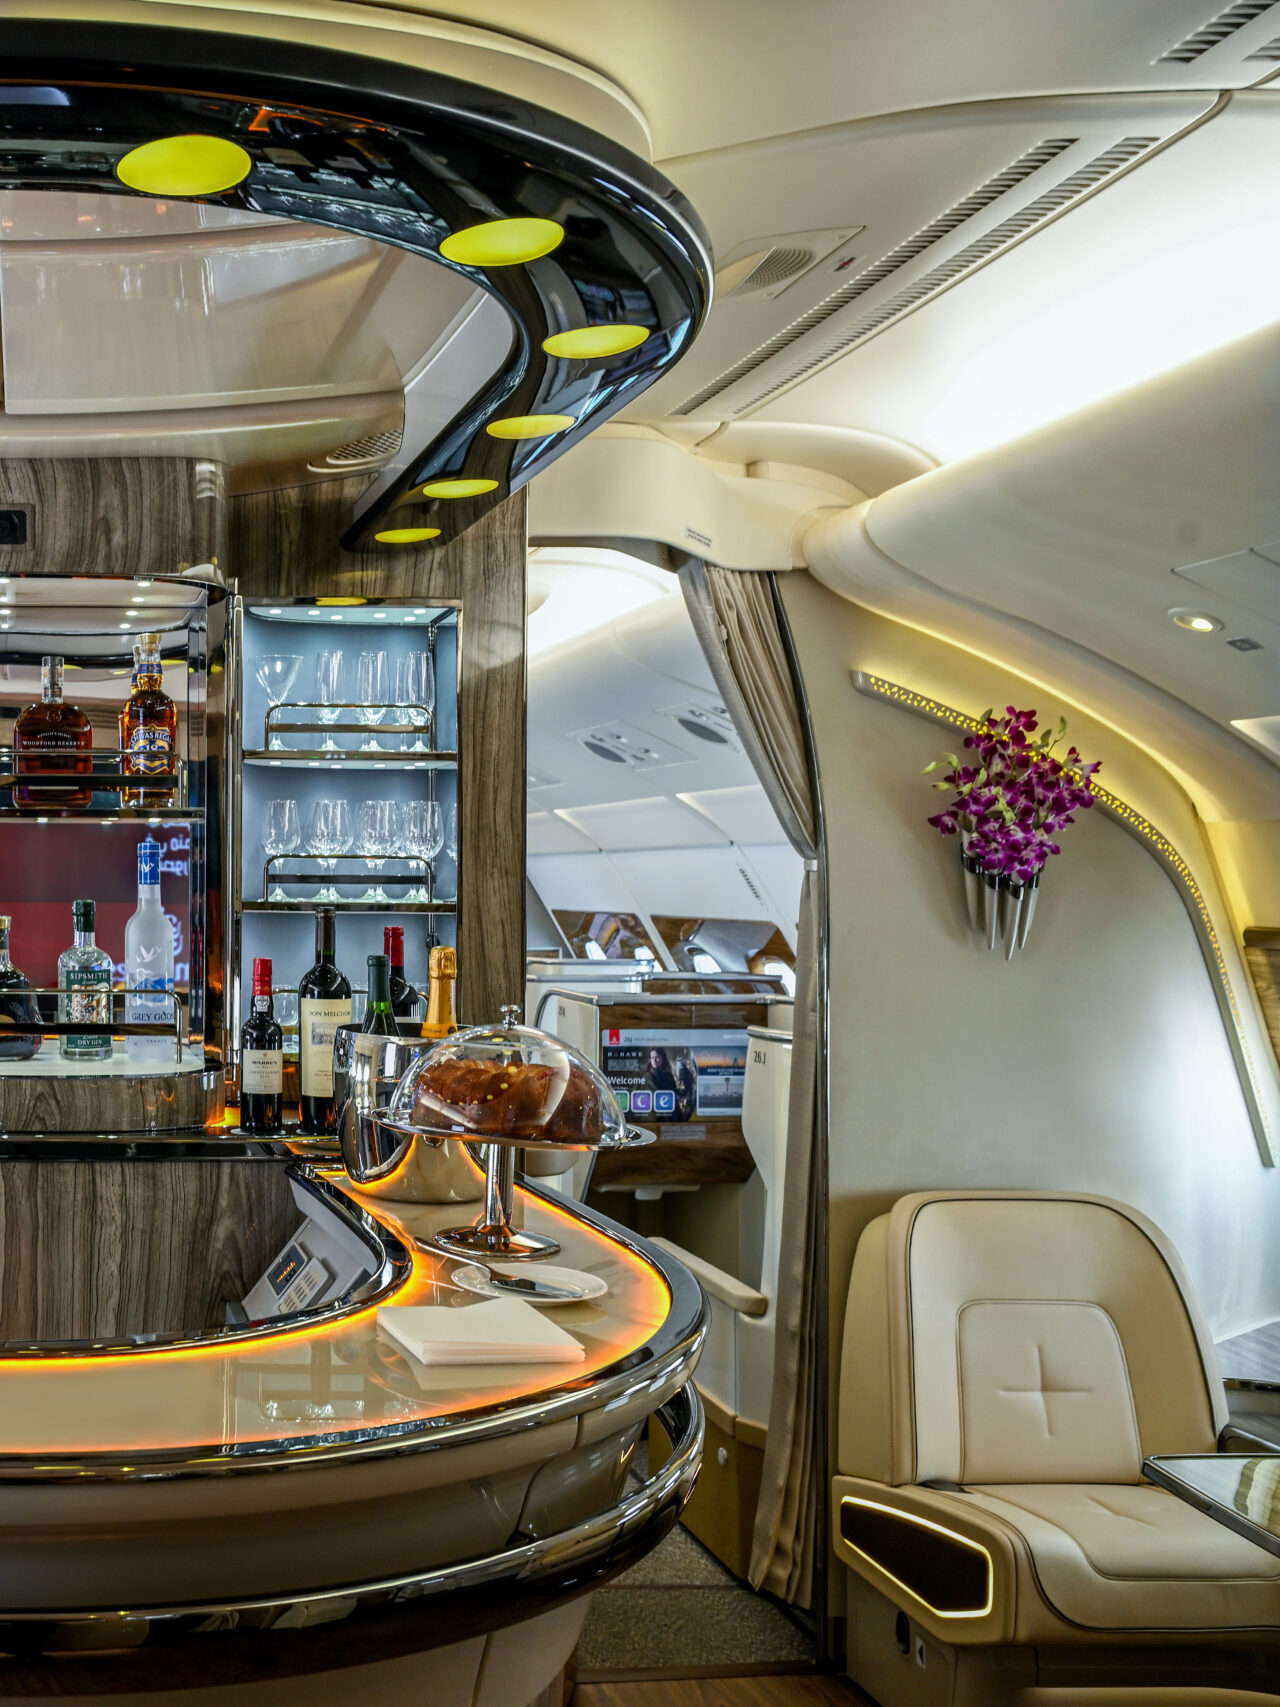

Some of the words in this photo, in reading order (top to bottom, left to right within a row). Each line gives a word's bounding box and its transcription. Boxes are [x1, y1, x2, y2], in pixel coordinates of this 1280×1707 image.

[131, 732, 154, 744] CHIVAS
[155, 732, 173, 744] REGAL
[132, 1012, 152, 1021] GREY
[754, 1051, 761, 1064] 26
[762, 1052, 766, 1064] J
[607, 1076, 646, 1084] Welcome
[637, 1095, 646, 1108] c
[659, 1095, 669, 1108] e
